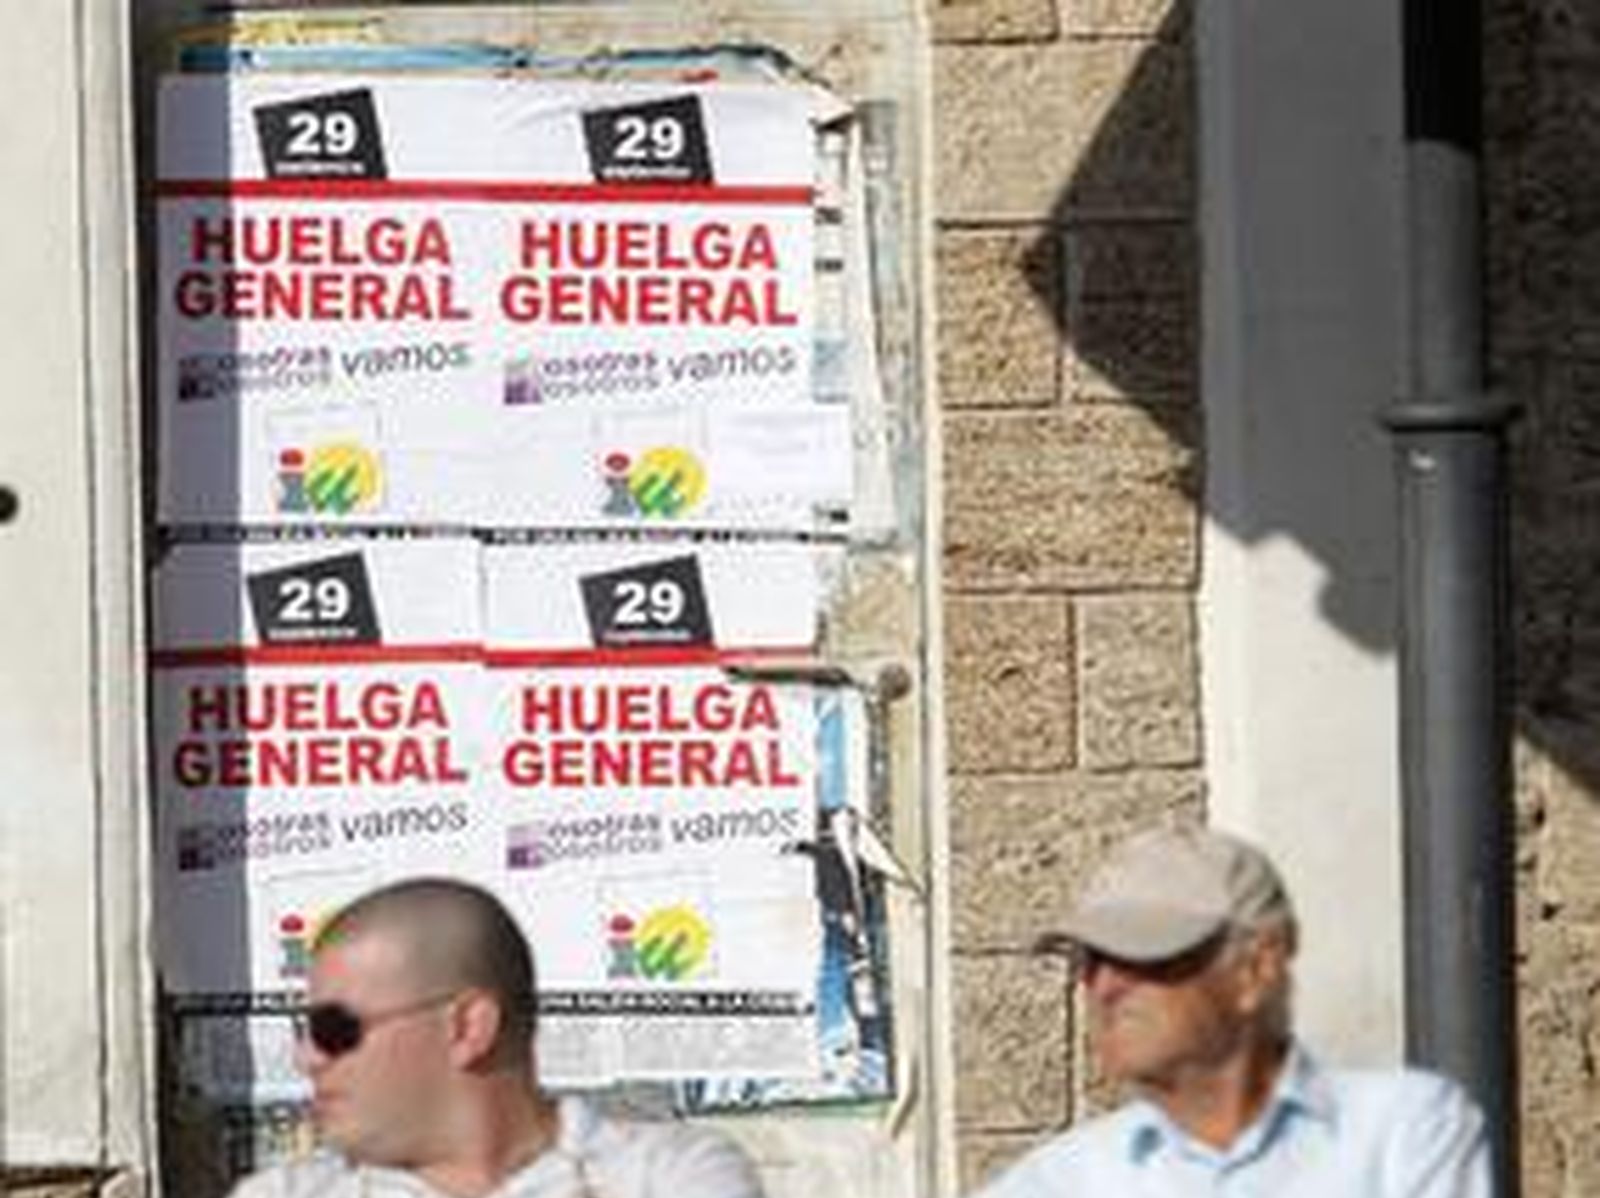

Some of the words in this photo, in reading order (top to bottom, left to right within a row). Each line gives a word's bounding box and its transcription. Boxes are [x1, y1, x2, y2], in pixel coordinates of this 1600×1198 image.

[287, 111, 357, 154] 29
[613, 117, 685, 158] 29
[191, 216, 452, 266] HUELGA
[520, 221, 778, 271] HUELGA
[175, 271, 472, 320] GENERAL
[501, 276, 799, 325] GENERAL
[341, 342, 470, 376] vamos
[667, 345, 797, 382] vamos
[279, 577, 350, 621] 29
[614, 581, 685, 624] 29
[188, 680, 448, 731] HUELGA
[521, 684, 780, 734] HUELGA
[173, 736, 469, 788] GENERAL
[503, 740, 800, 786] GENERAL
[341, 804, 468, 842] vamos
[670, 807, 801, 844] vamos
